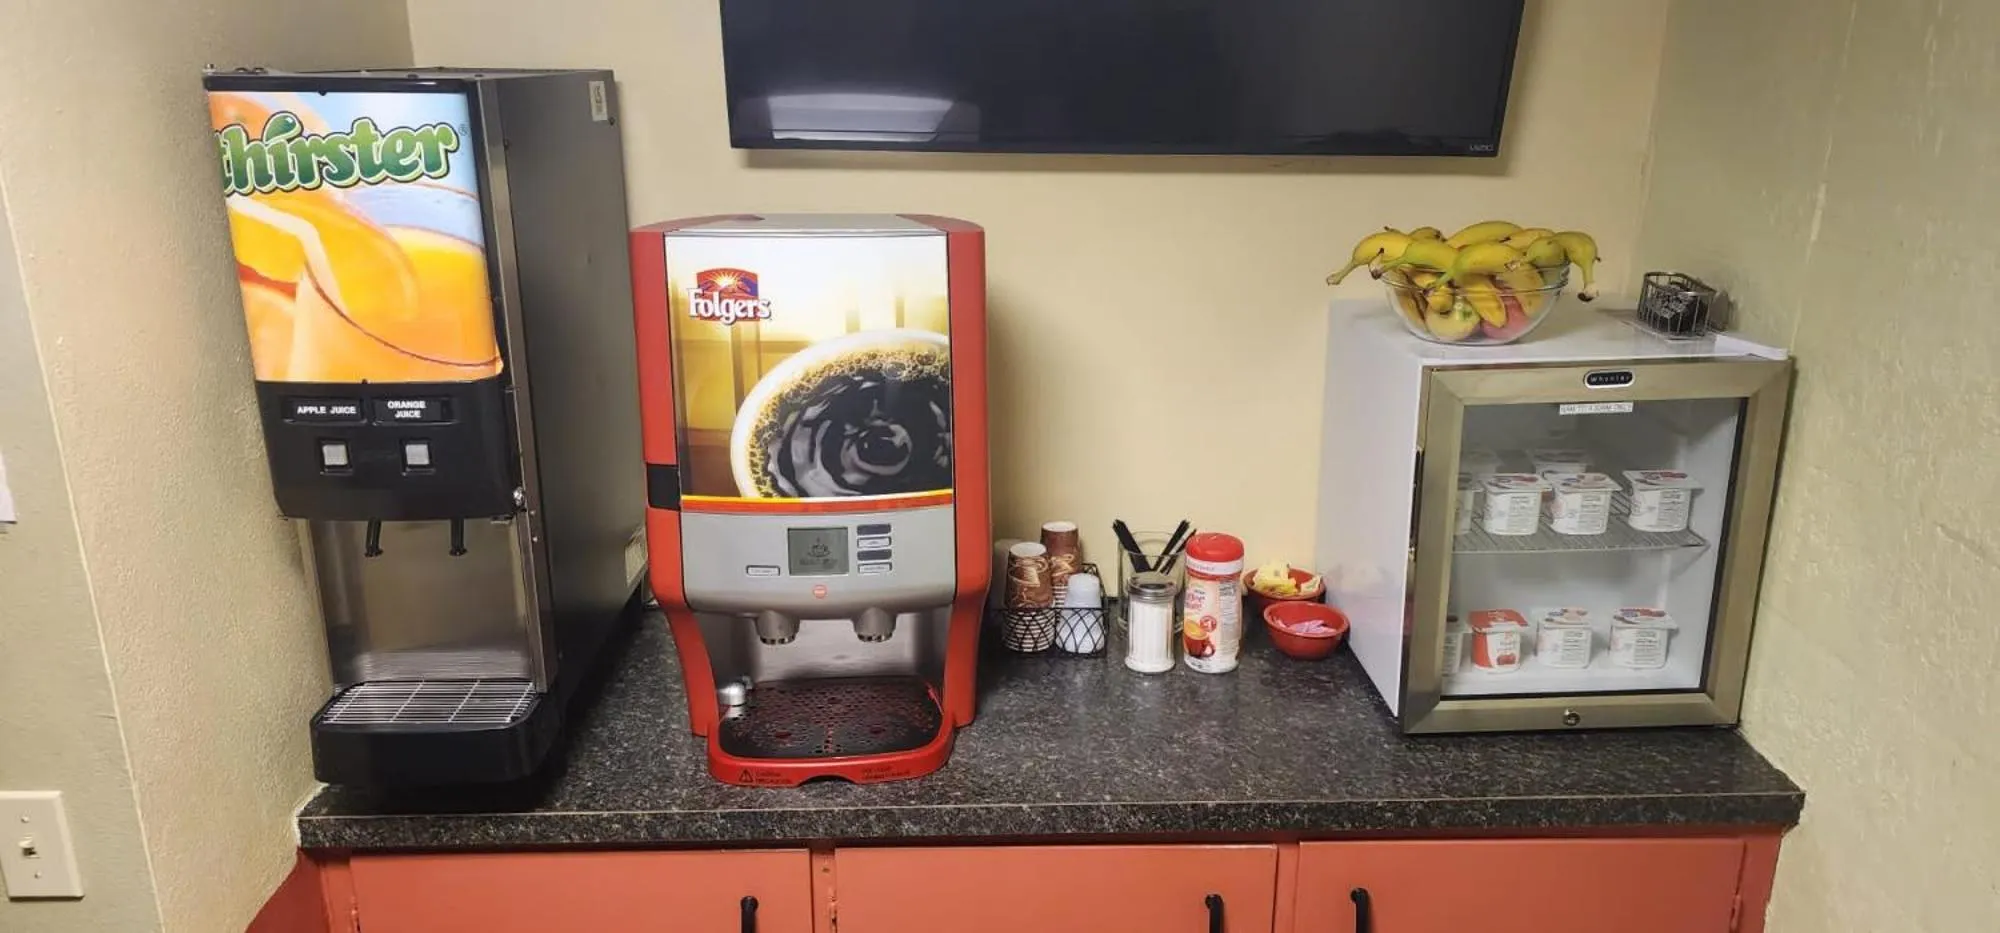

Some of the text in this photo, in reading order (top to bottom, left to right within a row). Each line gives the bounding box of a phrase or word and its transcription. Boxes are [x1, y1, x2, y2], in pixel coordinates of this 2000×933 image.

[688, 287, 772, 325] Folgers
[387, 400, 426, 409] ORANGE
[297, 406, 357, 415] APPLE JUICE
[394, 410, 421, 419] JUICE
